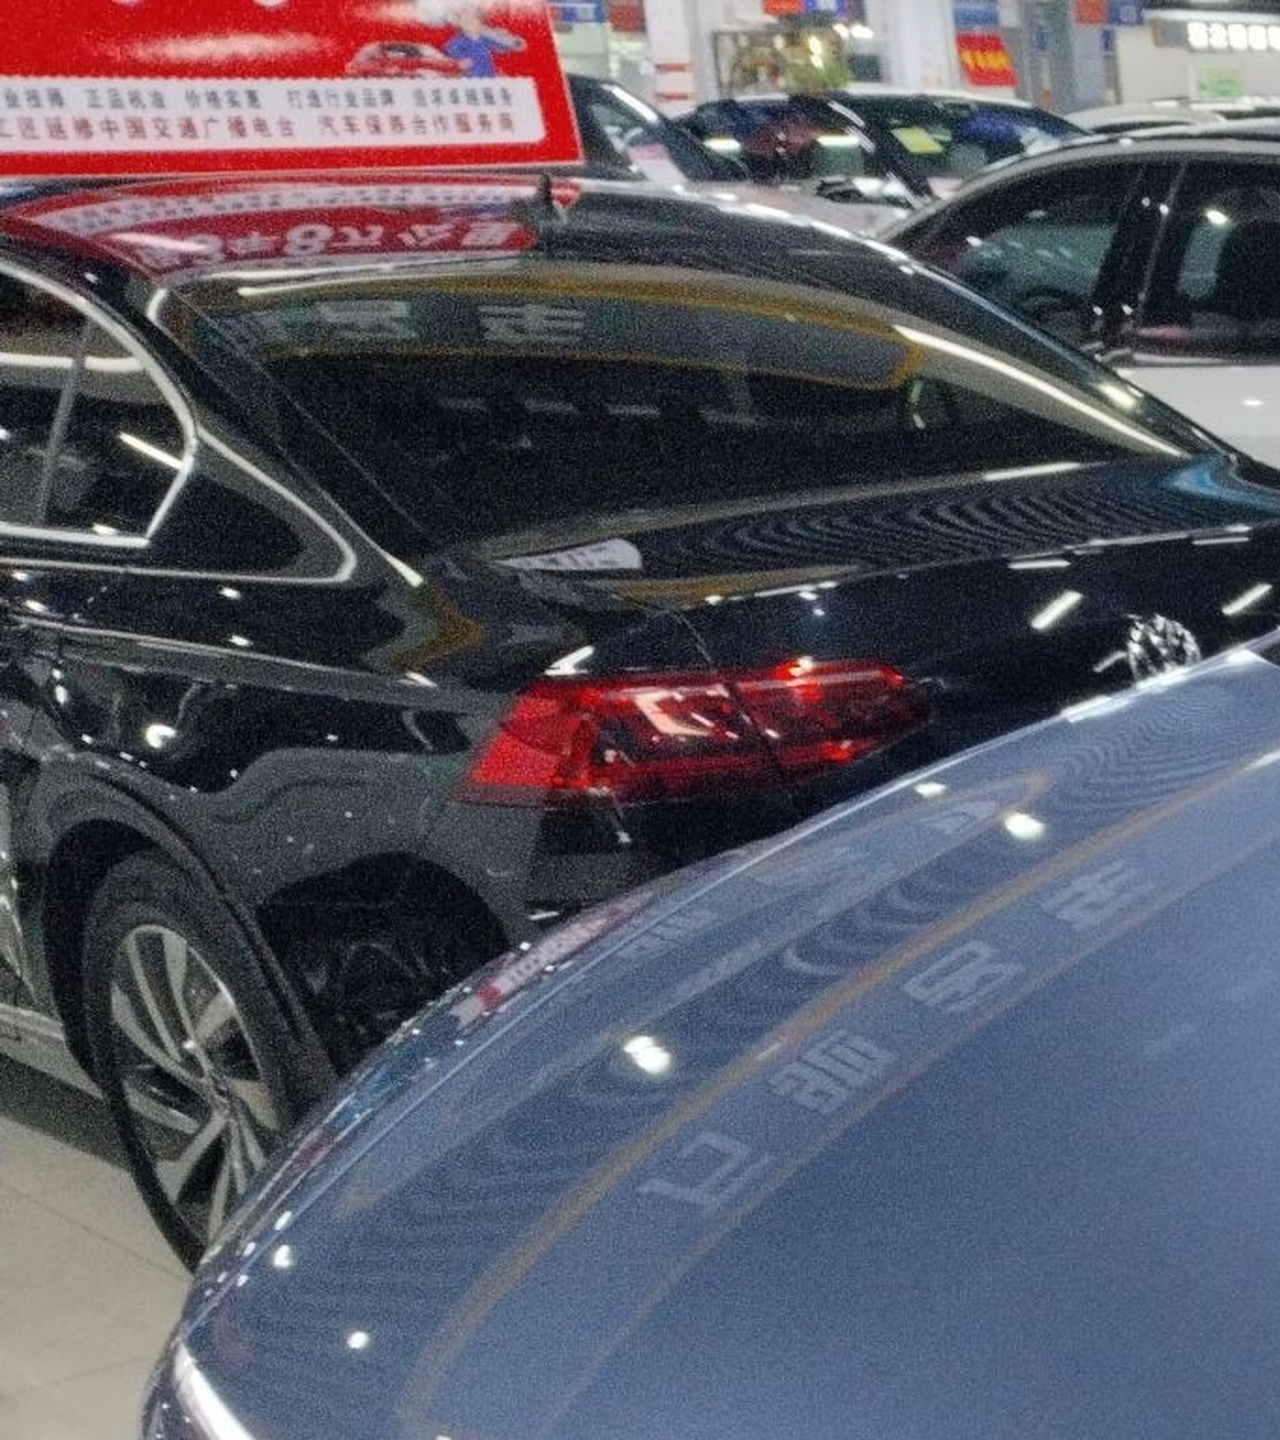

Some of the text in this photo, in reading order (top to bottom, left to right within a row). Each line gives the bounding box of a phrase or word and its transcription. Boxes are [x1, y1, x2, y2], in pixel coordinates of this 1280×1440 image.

[185, 87, 260, 109] 价格实惠
[286, 87, 394, 109] 打造行业品牌
